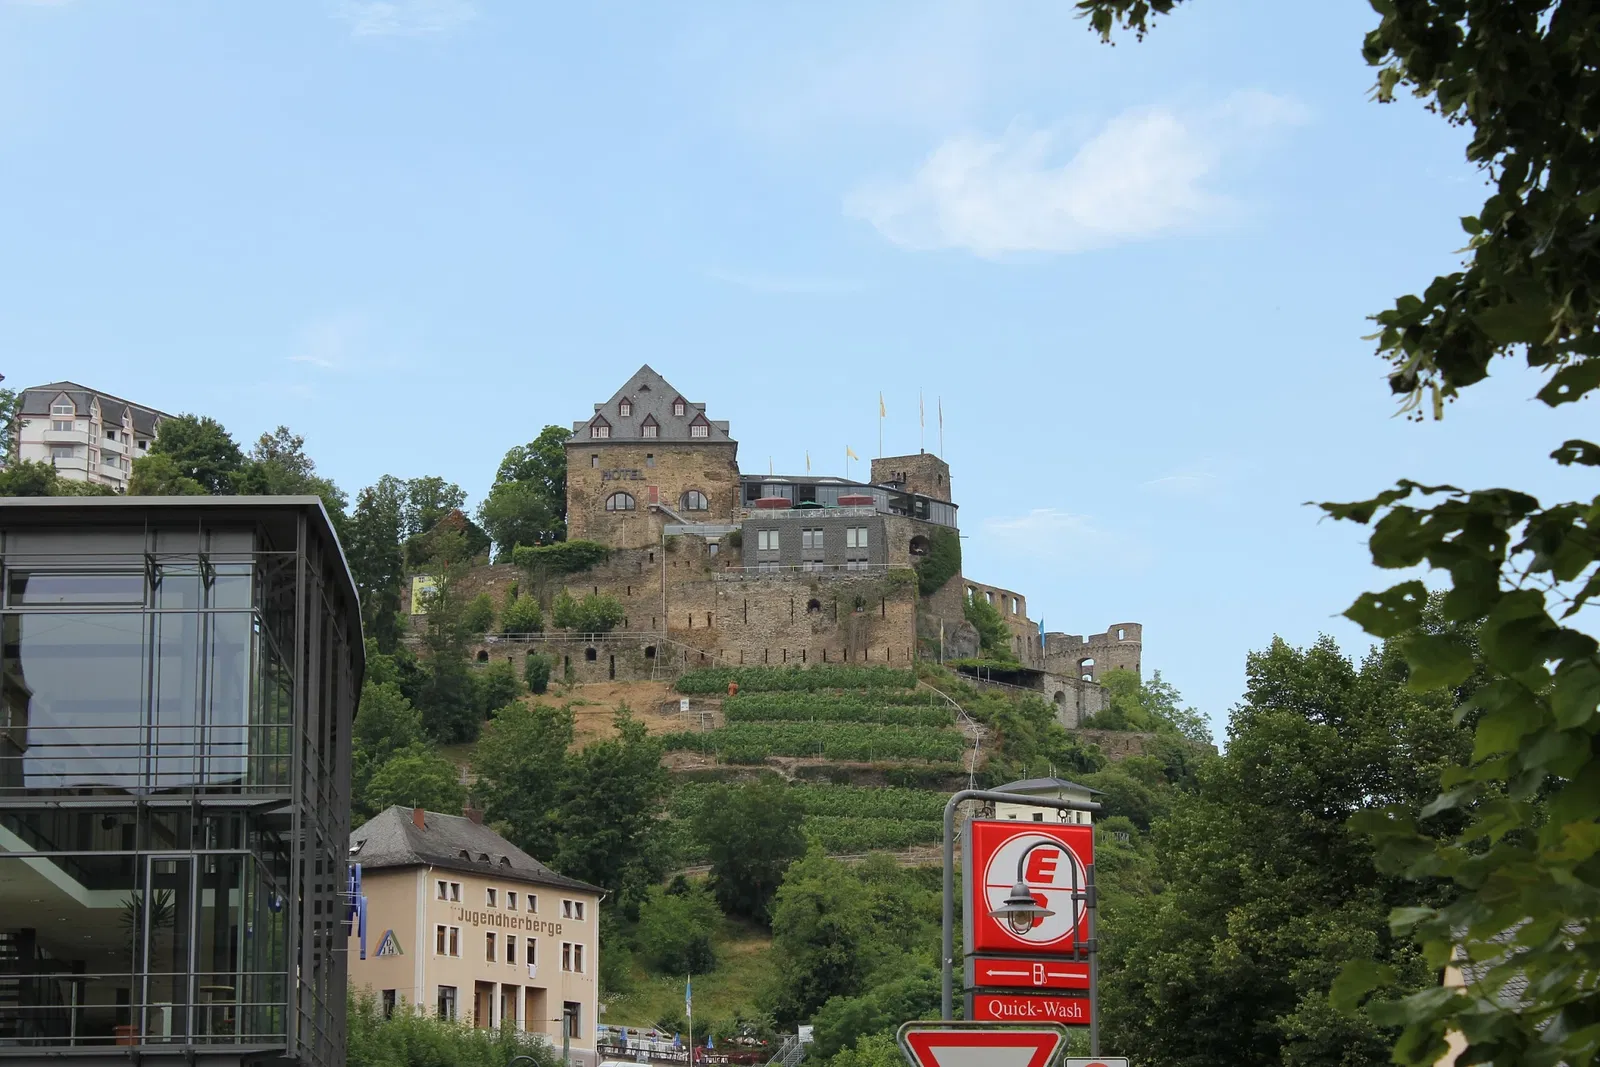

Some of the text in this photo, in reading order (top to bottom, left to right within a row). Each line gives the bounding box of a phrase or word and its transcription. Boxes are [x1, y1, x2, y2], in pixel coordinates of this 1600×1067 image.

[601, 469, 647, 481] HOTEL
[1025, 848, 1060, 884] E
[457, 907, 562, 937] Jugendherberge
[988, 999, 1082, 1019] Quick-Wash
